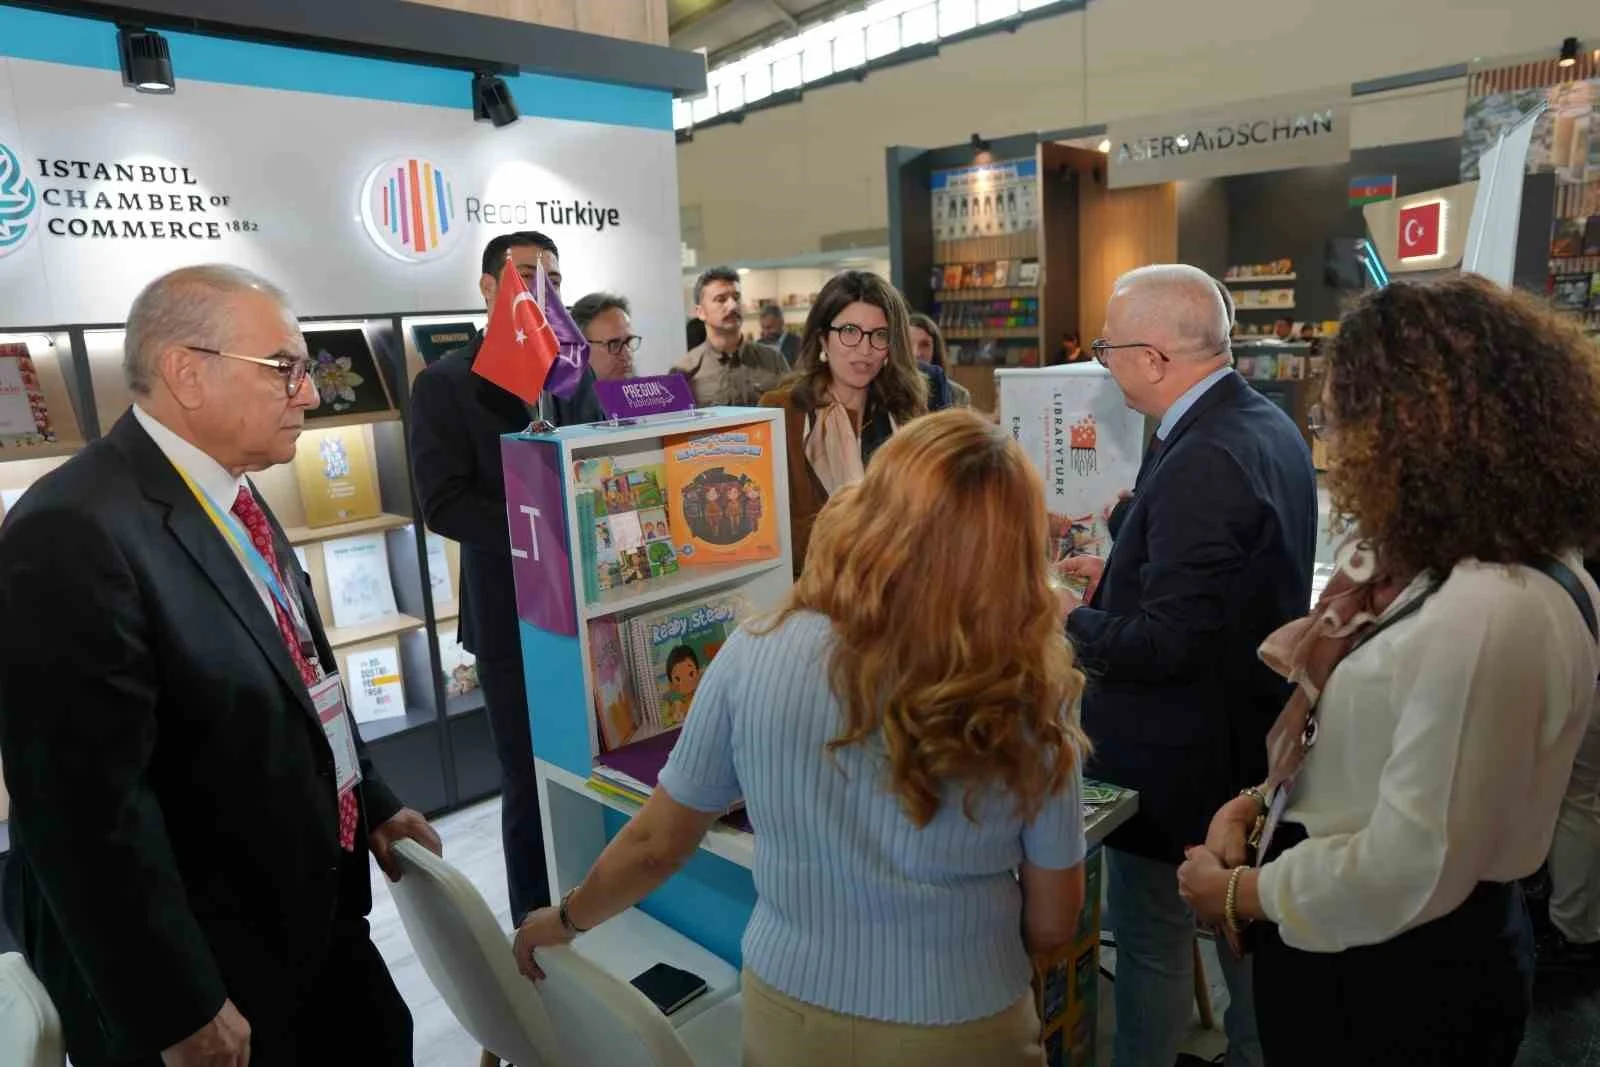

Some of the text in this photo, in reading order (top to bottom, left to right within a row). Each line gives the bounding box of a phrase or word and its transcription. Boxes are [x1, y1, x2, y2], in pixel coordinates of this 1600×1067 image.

[37, 158, 198, 185] ISTANBUL
[42, 188, 231, 213] CHAMBER OF
[465, 196, 620, 231] Read Türkiye
[47, 217, 260, 240] COMMERCE 1882
